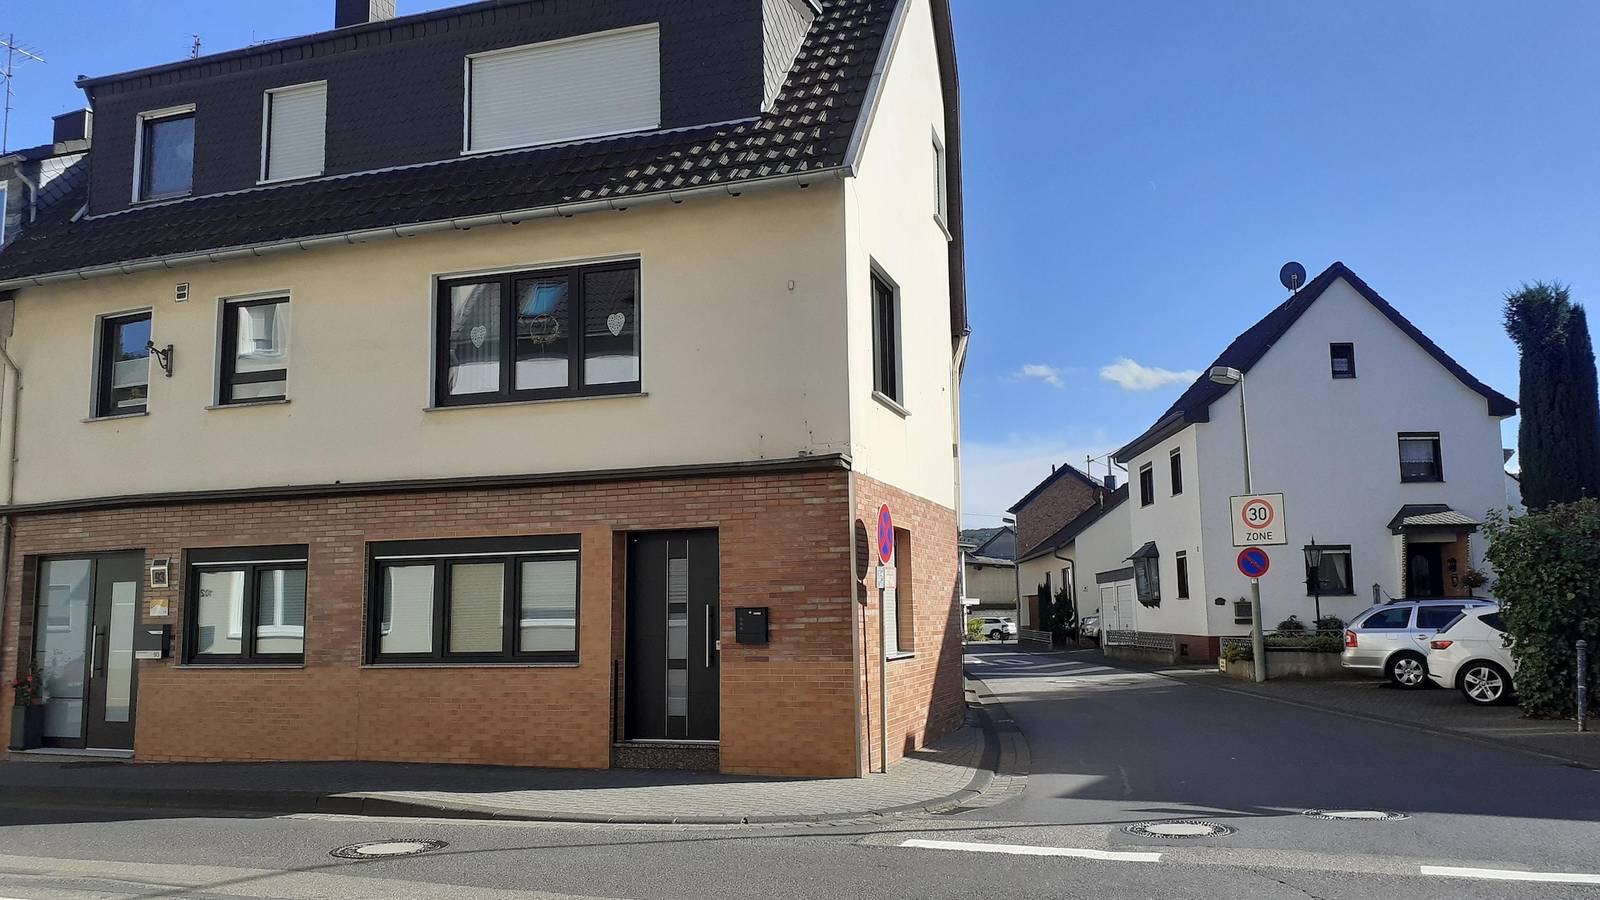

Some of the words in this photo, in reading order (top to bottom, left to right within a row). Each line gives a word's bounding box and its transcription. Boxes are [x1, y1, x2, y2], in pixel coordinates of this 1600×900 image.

[1248, 507, 1267, 521] 30
[1246, 531, 1273, 541] ZONE
[155, 571, 165, 583] 93
